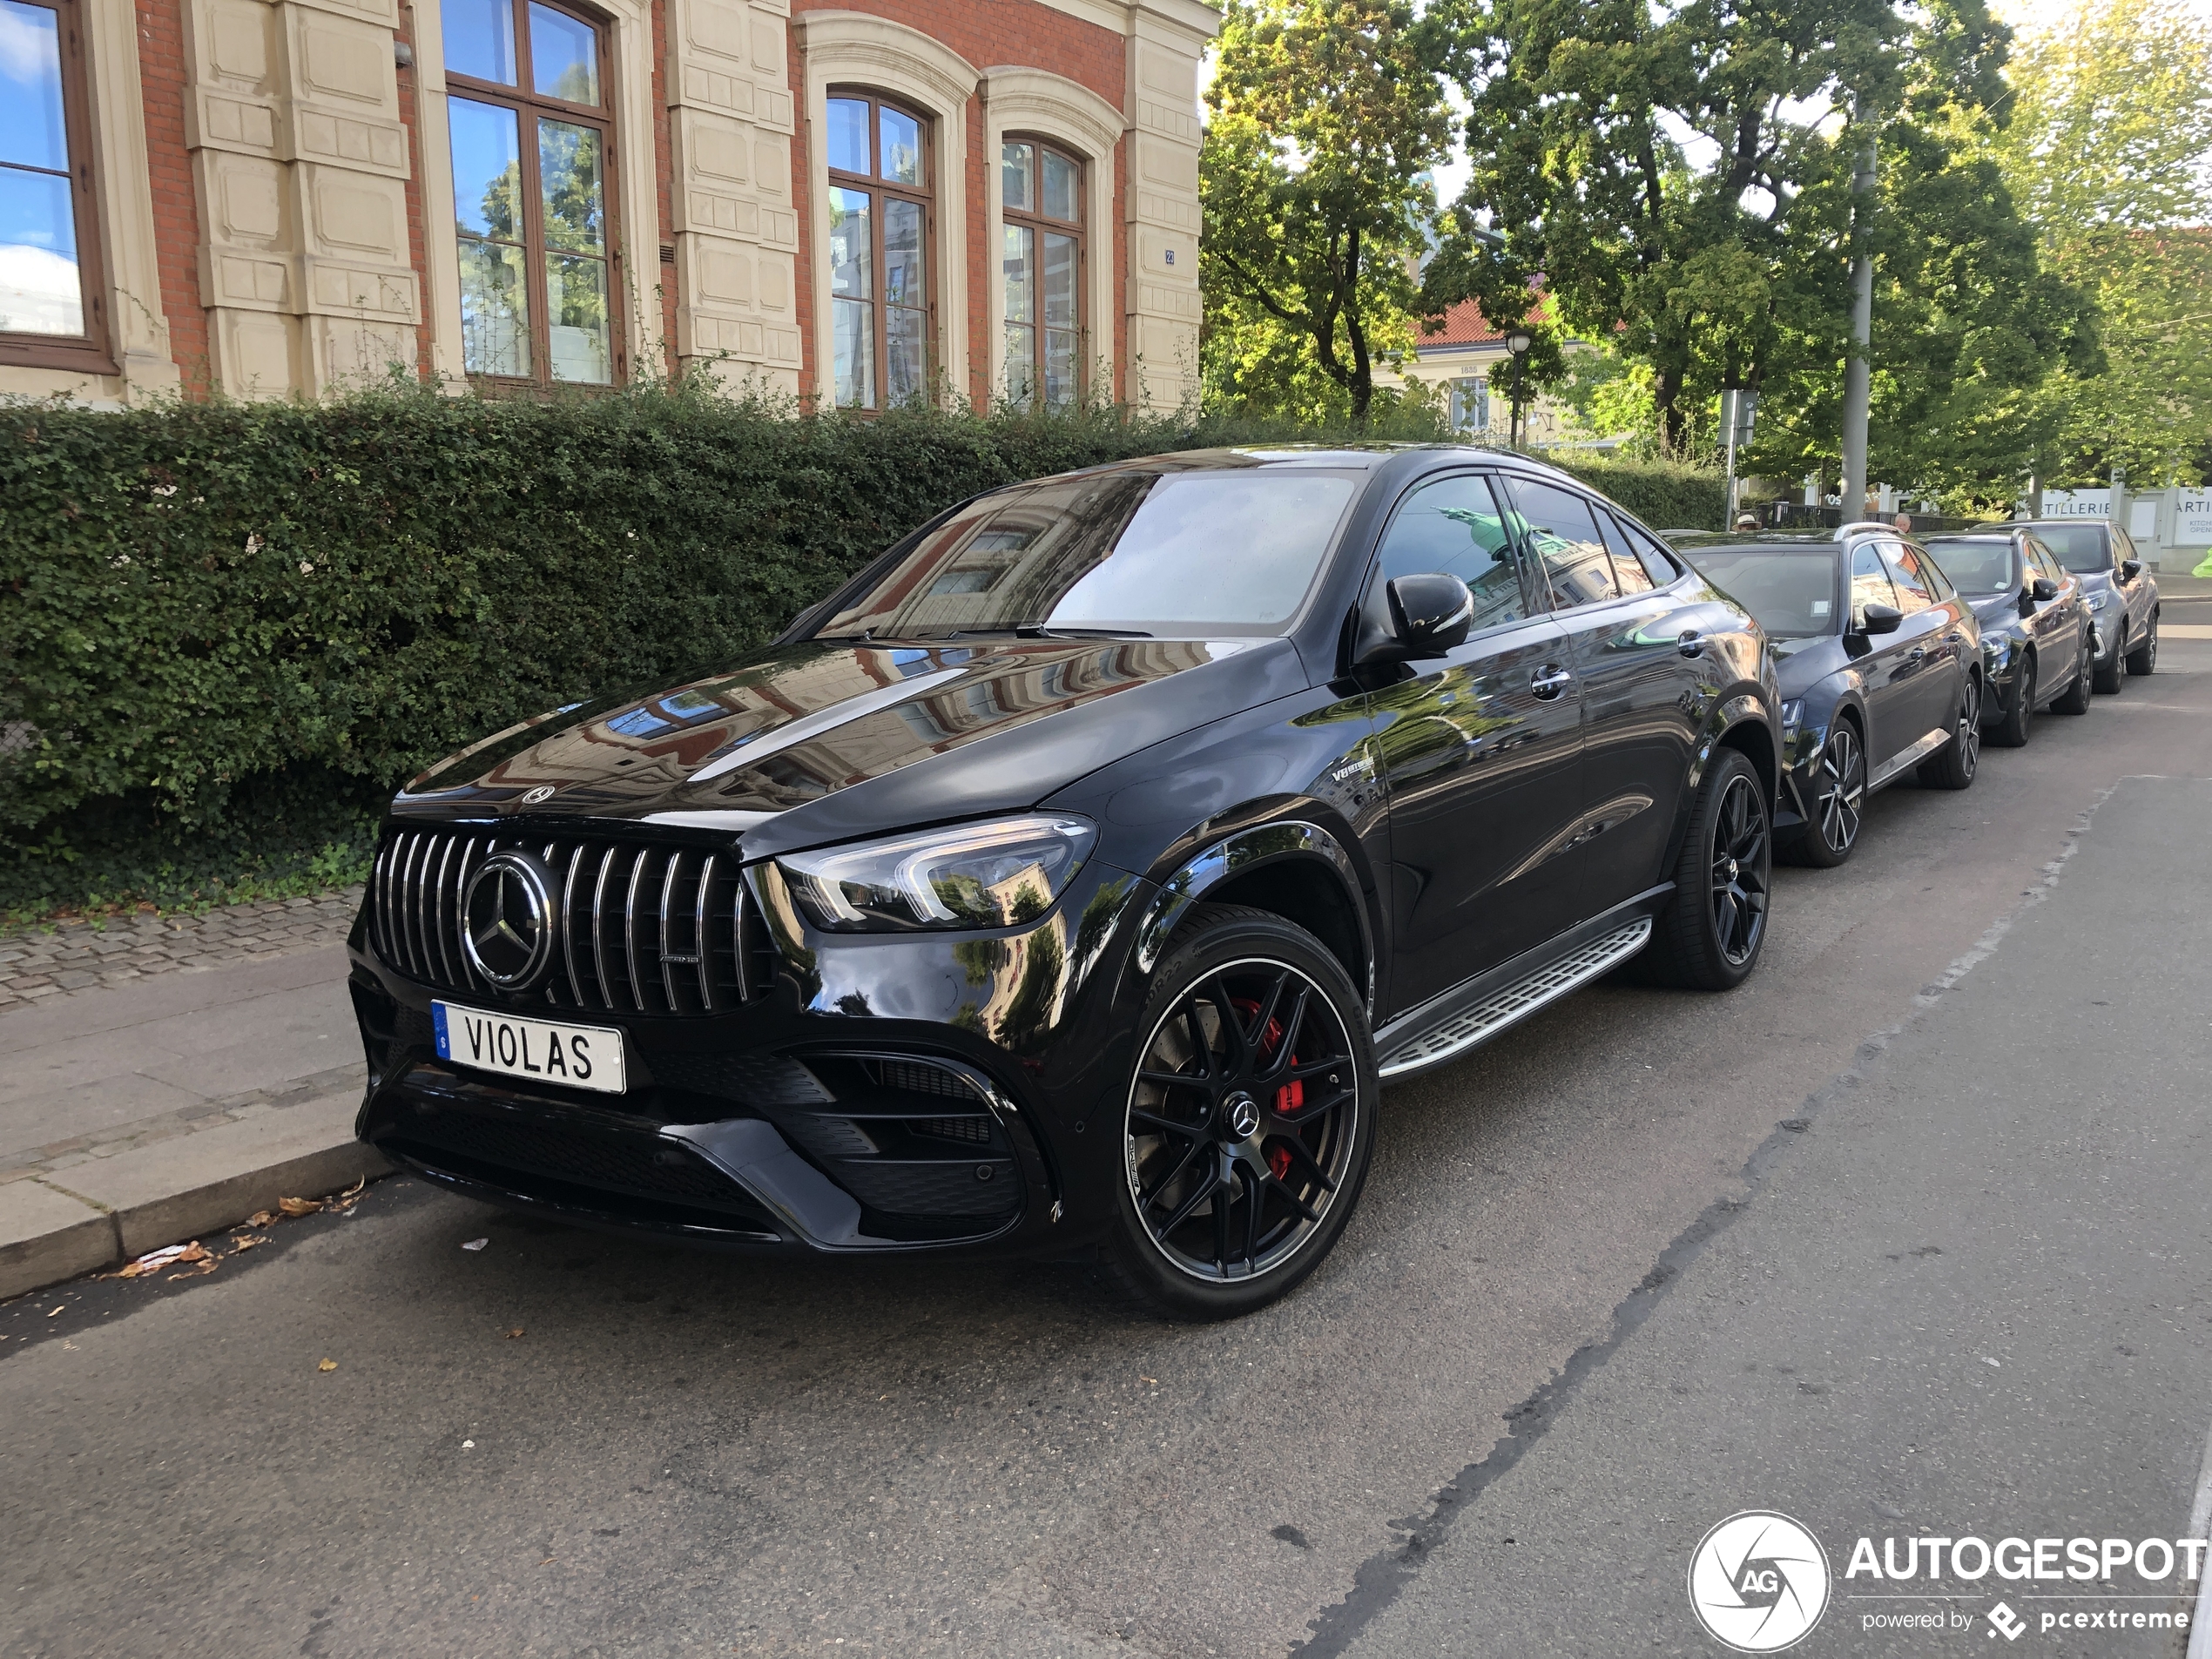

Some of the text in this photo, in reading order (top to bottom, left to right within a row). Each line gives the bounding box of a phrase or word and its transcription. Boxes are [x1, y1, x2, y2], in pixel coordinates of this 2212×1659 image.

[2041, 502, 2110, 515] TILLERIE
[1332, 767, 1349, 782] V8
[440, 1036, 447, 1049] S
[465, 1015, 593, 1080] VIOLAS
